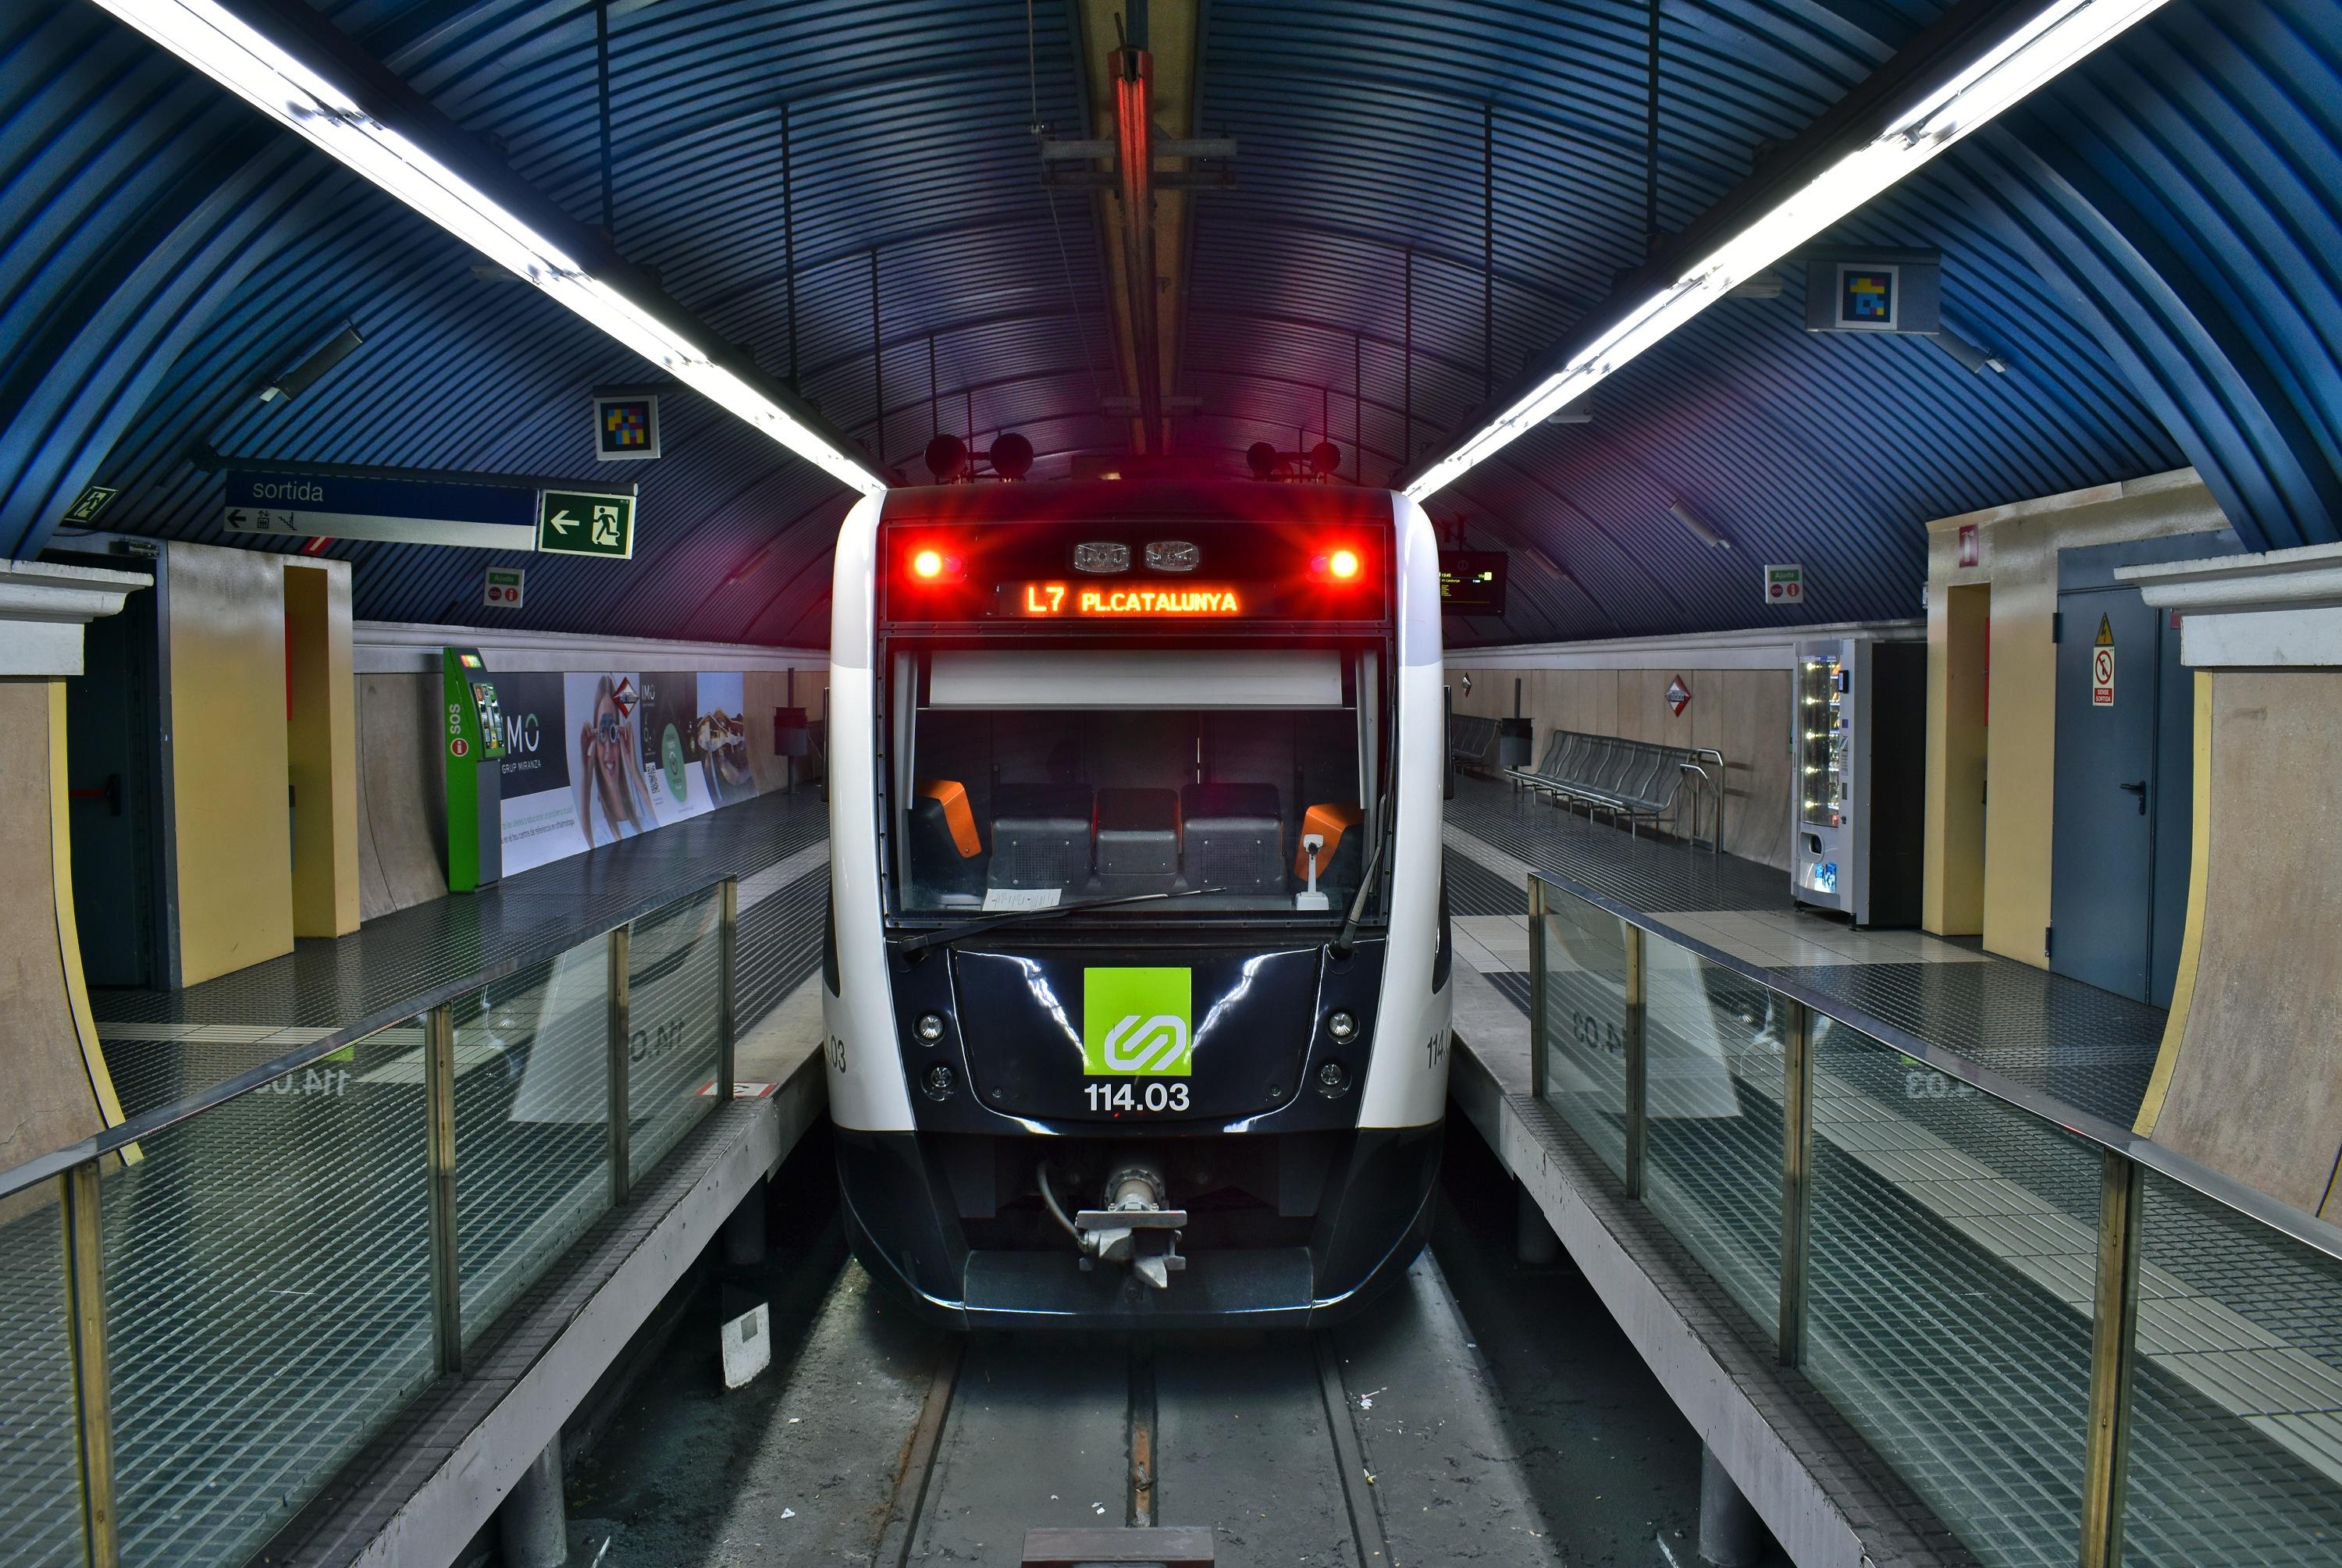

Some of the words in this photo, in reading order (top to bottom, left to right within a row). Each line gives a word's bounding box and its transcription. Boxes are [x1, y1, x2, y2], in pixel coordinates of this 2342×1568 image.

[253, 481, 323, 502] sortida
[1774, 571, 1795, 581] Ajuda
[1027, 586, 1064, 612] L7
[1082, 593, 1238, 611] PL.CATALUNYA
[642, 684, 656, 700] IMO
[450, 704, 461, 734] SOS
[502, 713, 539, 755] MO
[502, 763, 516, 773] GRUP
[518, 759, 542, 771] MIRANZA
[1084, 1083, 1190, 1111] 114.03
